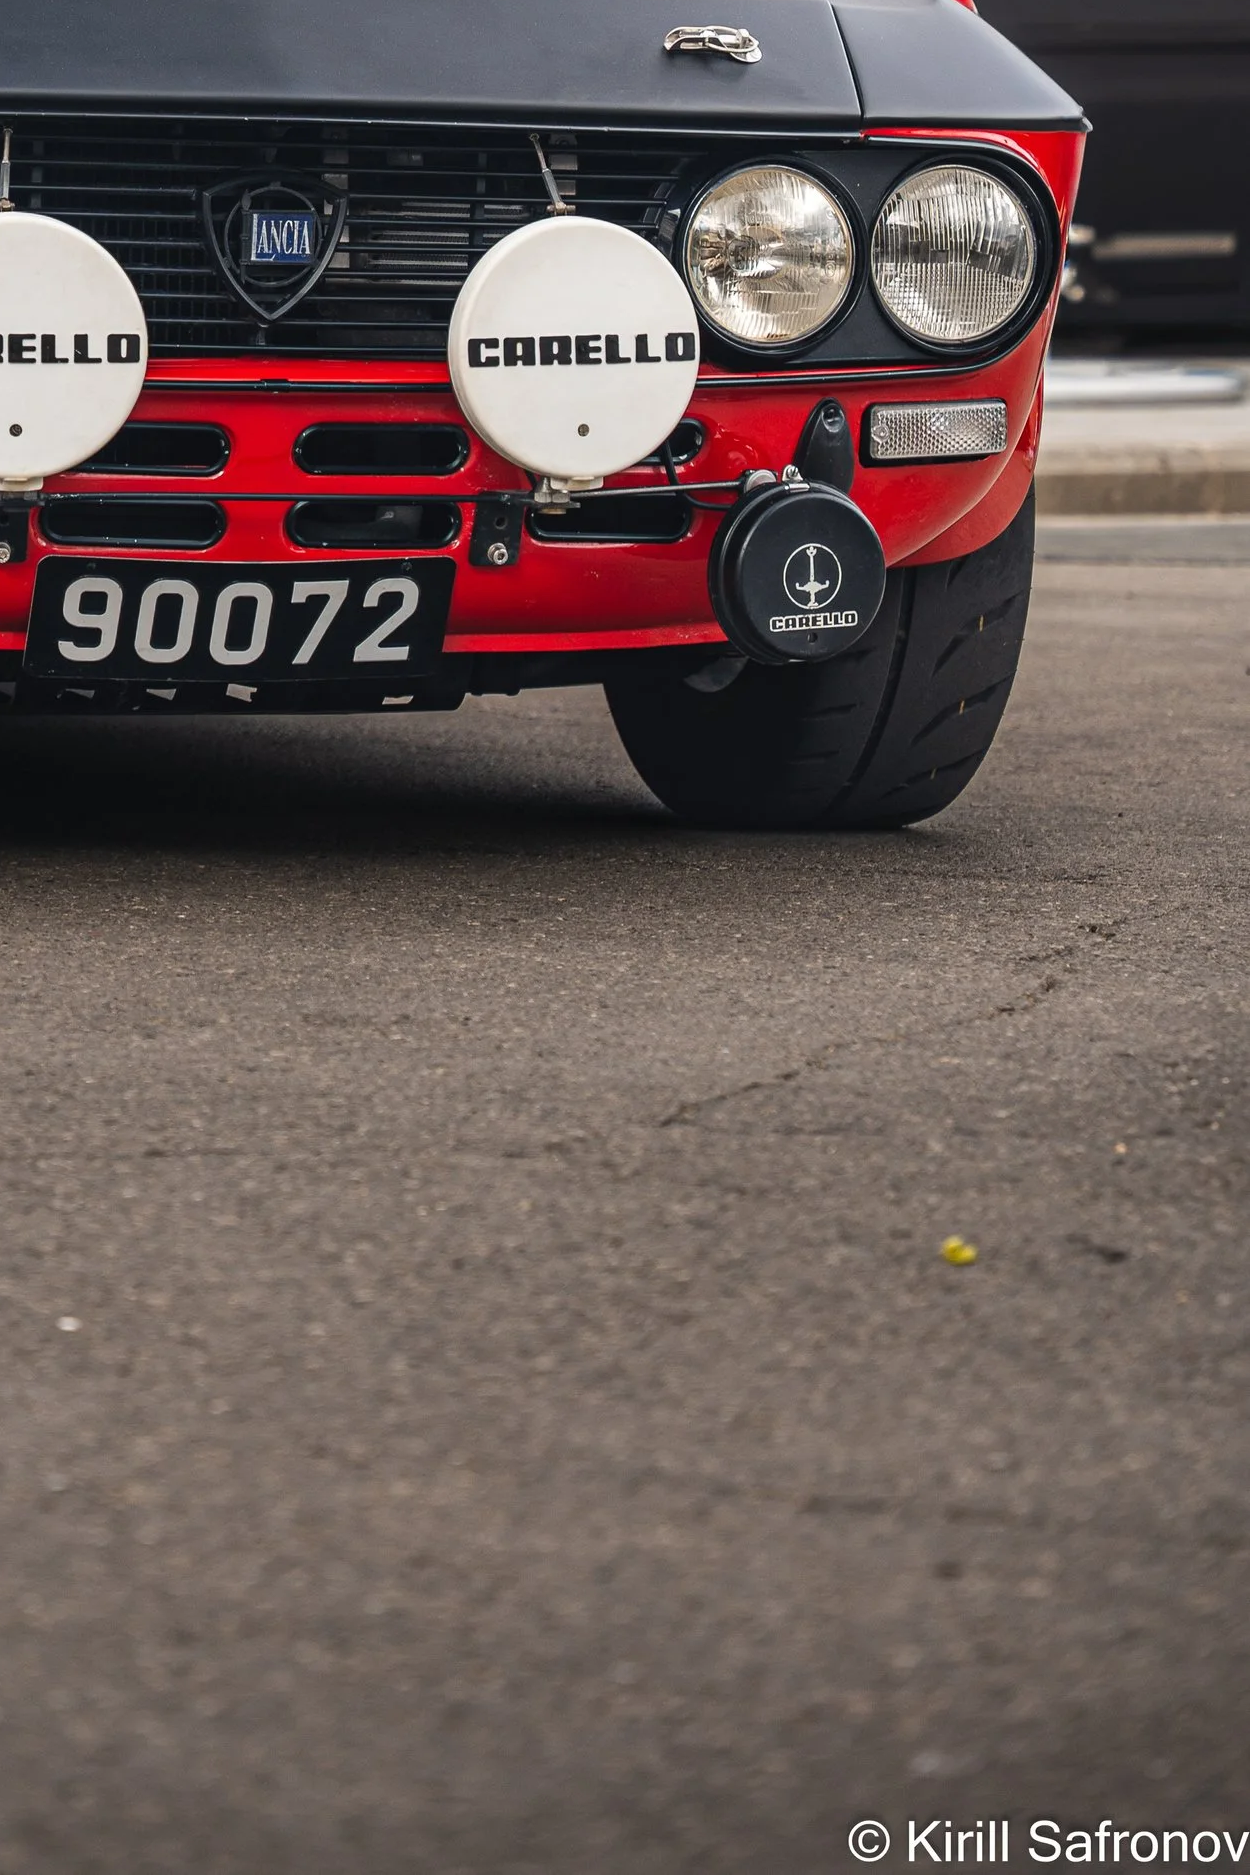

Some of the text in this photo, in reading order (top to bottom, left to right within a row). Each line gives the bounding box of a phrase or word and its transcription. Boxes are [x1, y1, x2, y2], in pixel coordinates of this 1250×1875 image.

[251, 213, 311, 261] LANCIA
[467, 332, 696, 367] CARELLO
[57, 577, 420, 666] 90072
[770, 611, 858, 632] CARELLO
